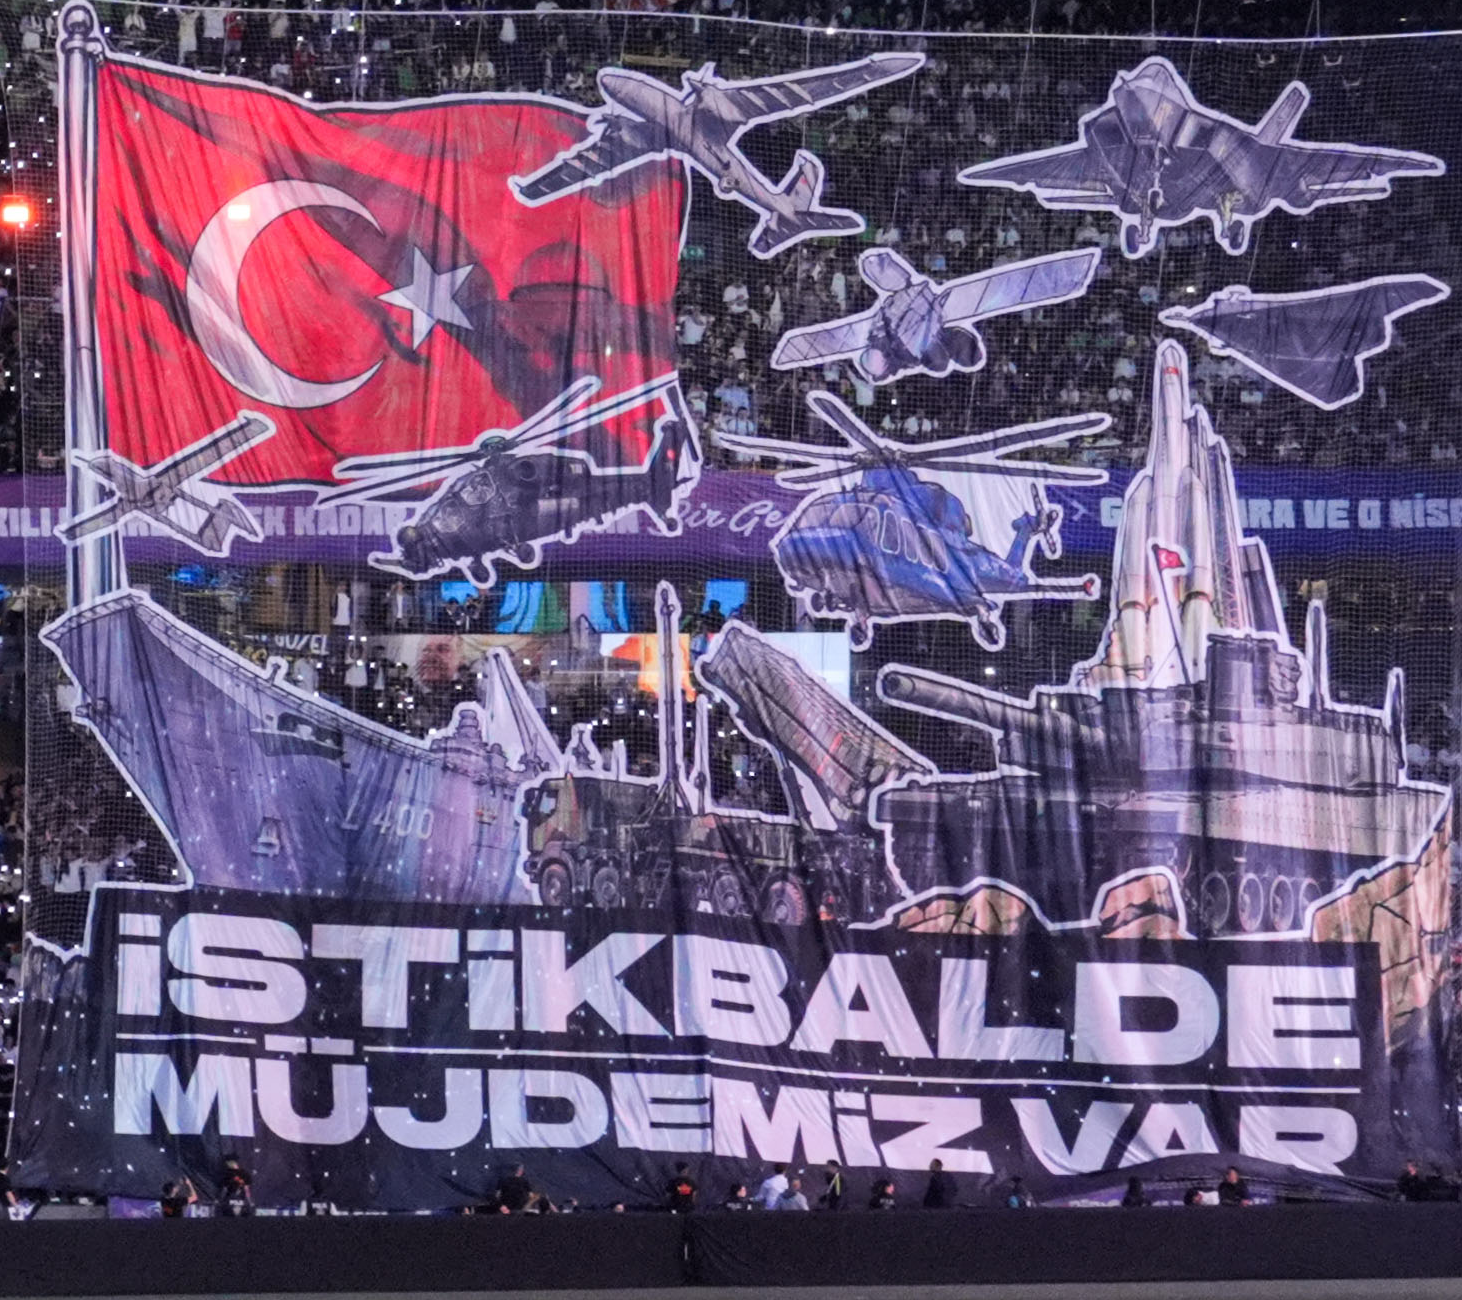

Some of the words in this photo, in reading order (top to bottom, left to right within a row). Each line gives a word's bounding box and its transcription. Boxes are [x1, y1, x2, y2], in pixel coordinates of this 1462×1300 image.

[116, 912, 1362, 1070] İSTİKBALDE
[113, 1034, 995, 1175] MÜJDEMİZ
[1010, 1098, 1358, 1177] VAR
